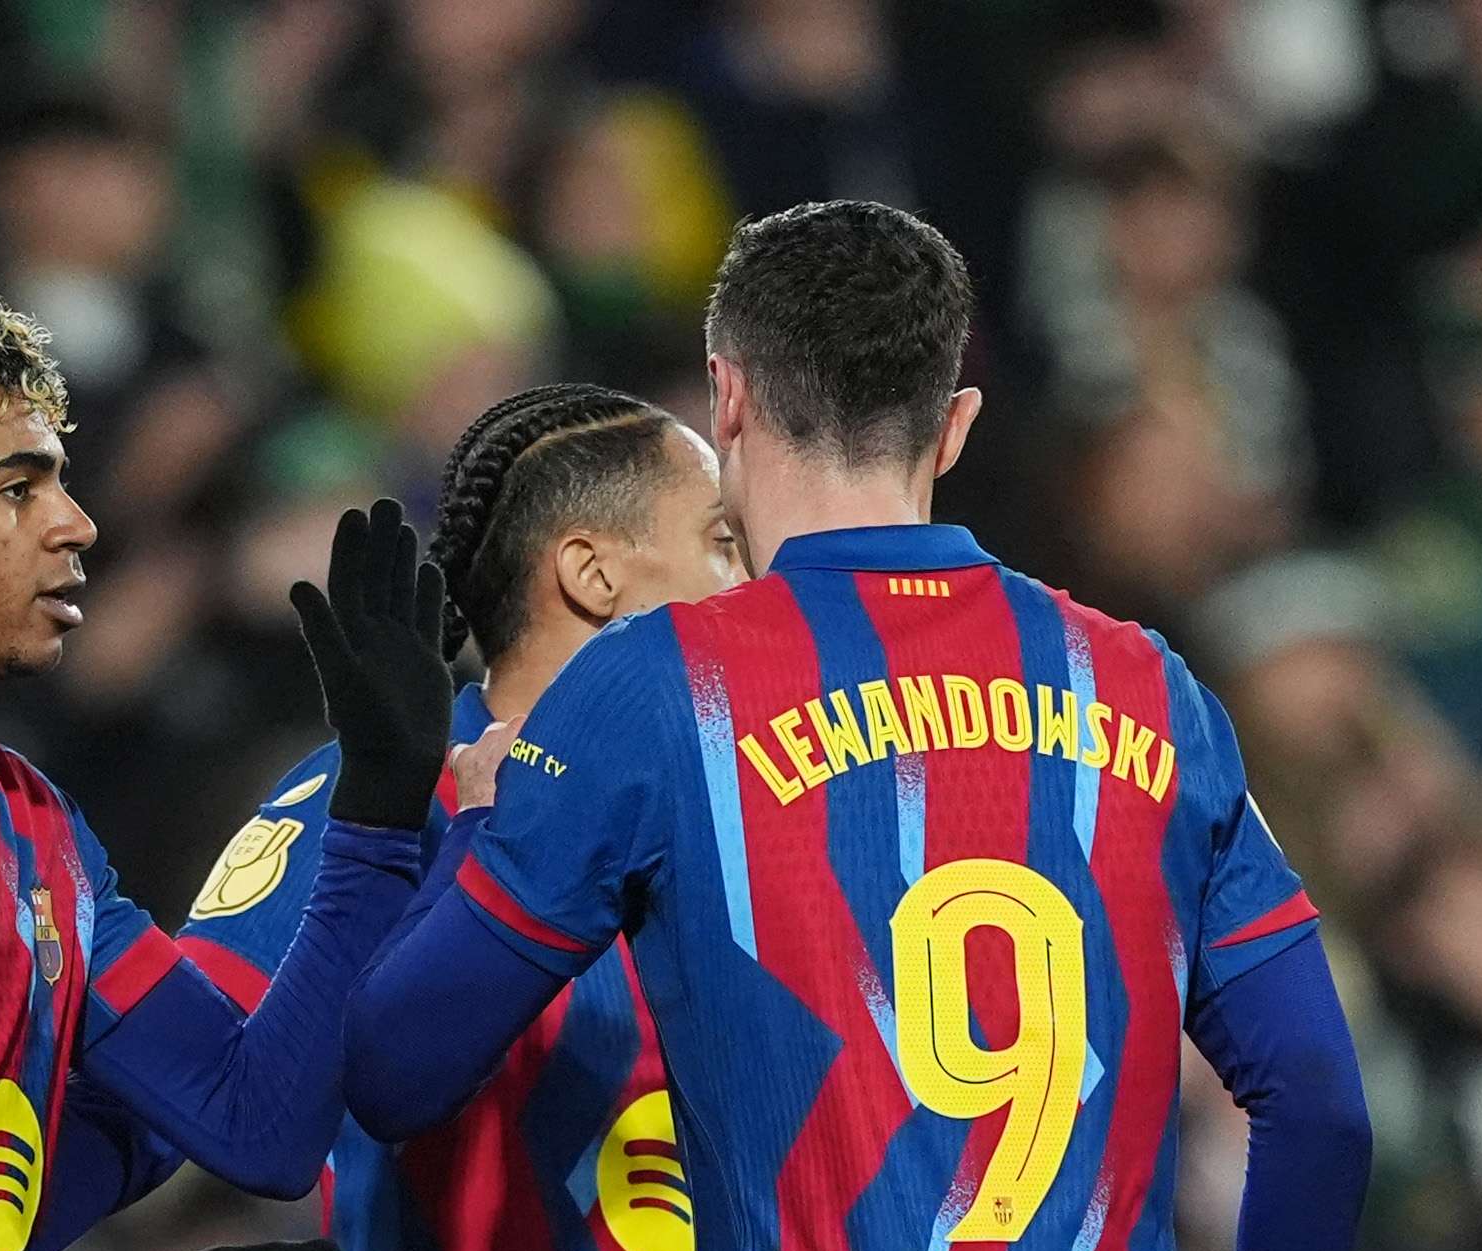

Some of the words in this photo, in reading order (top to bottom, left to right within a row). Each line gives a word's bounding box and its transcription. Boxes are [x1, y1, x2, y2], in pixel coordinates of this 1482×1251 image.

[544, 755, 567, 778] tv
[738, 674, 1176, 806] LEWANDOWSKI
[889, 858, 1085, 1242] 9
